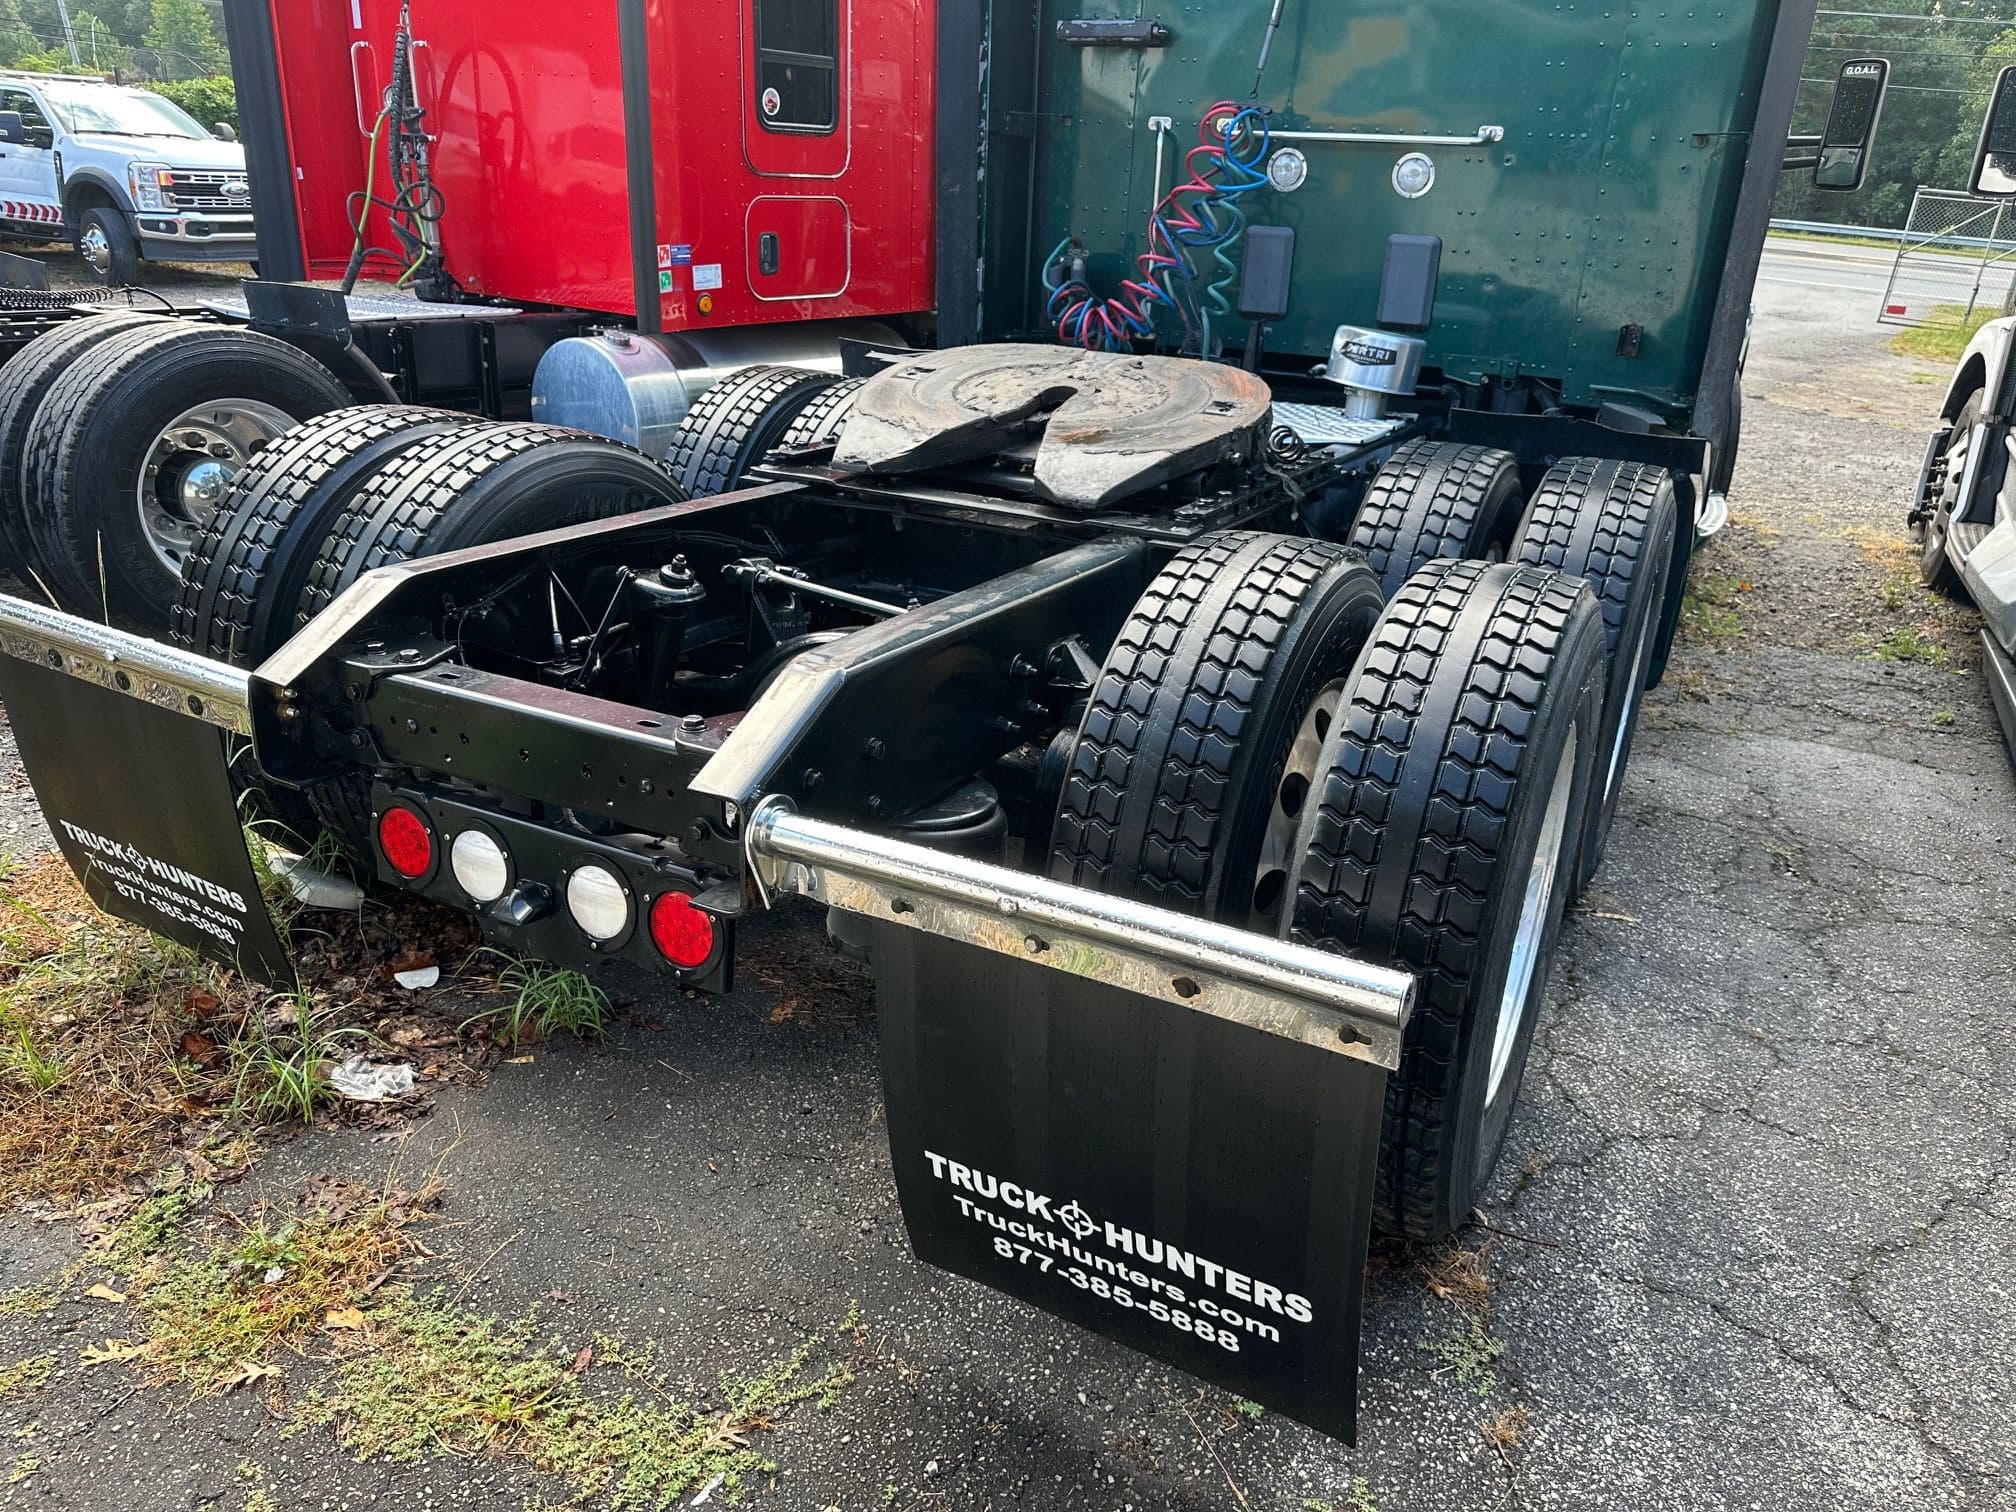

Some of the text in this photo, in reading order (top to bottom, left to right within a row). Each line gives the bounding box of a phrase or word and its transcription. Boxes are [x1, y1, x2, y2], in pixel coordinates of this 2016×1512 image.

[59, 818, 248, 913] TRUCK HUNTERS
[84, 851, 245, 932] TruckHunters.com
[114, 880, 236, 946] 877-385-5888
[924, 1149, 1313, 1323] TRUCK HUNTERS
[953, 1194, 1281, 1344] TruckHunters.com
[993, 1236, 1240, 1354] 877-385-5888
